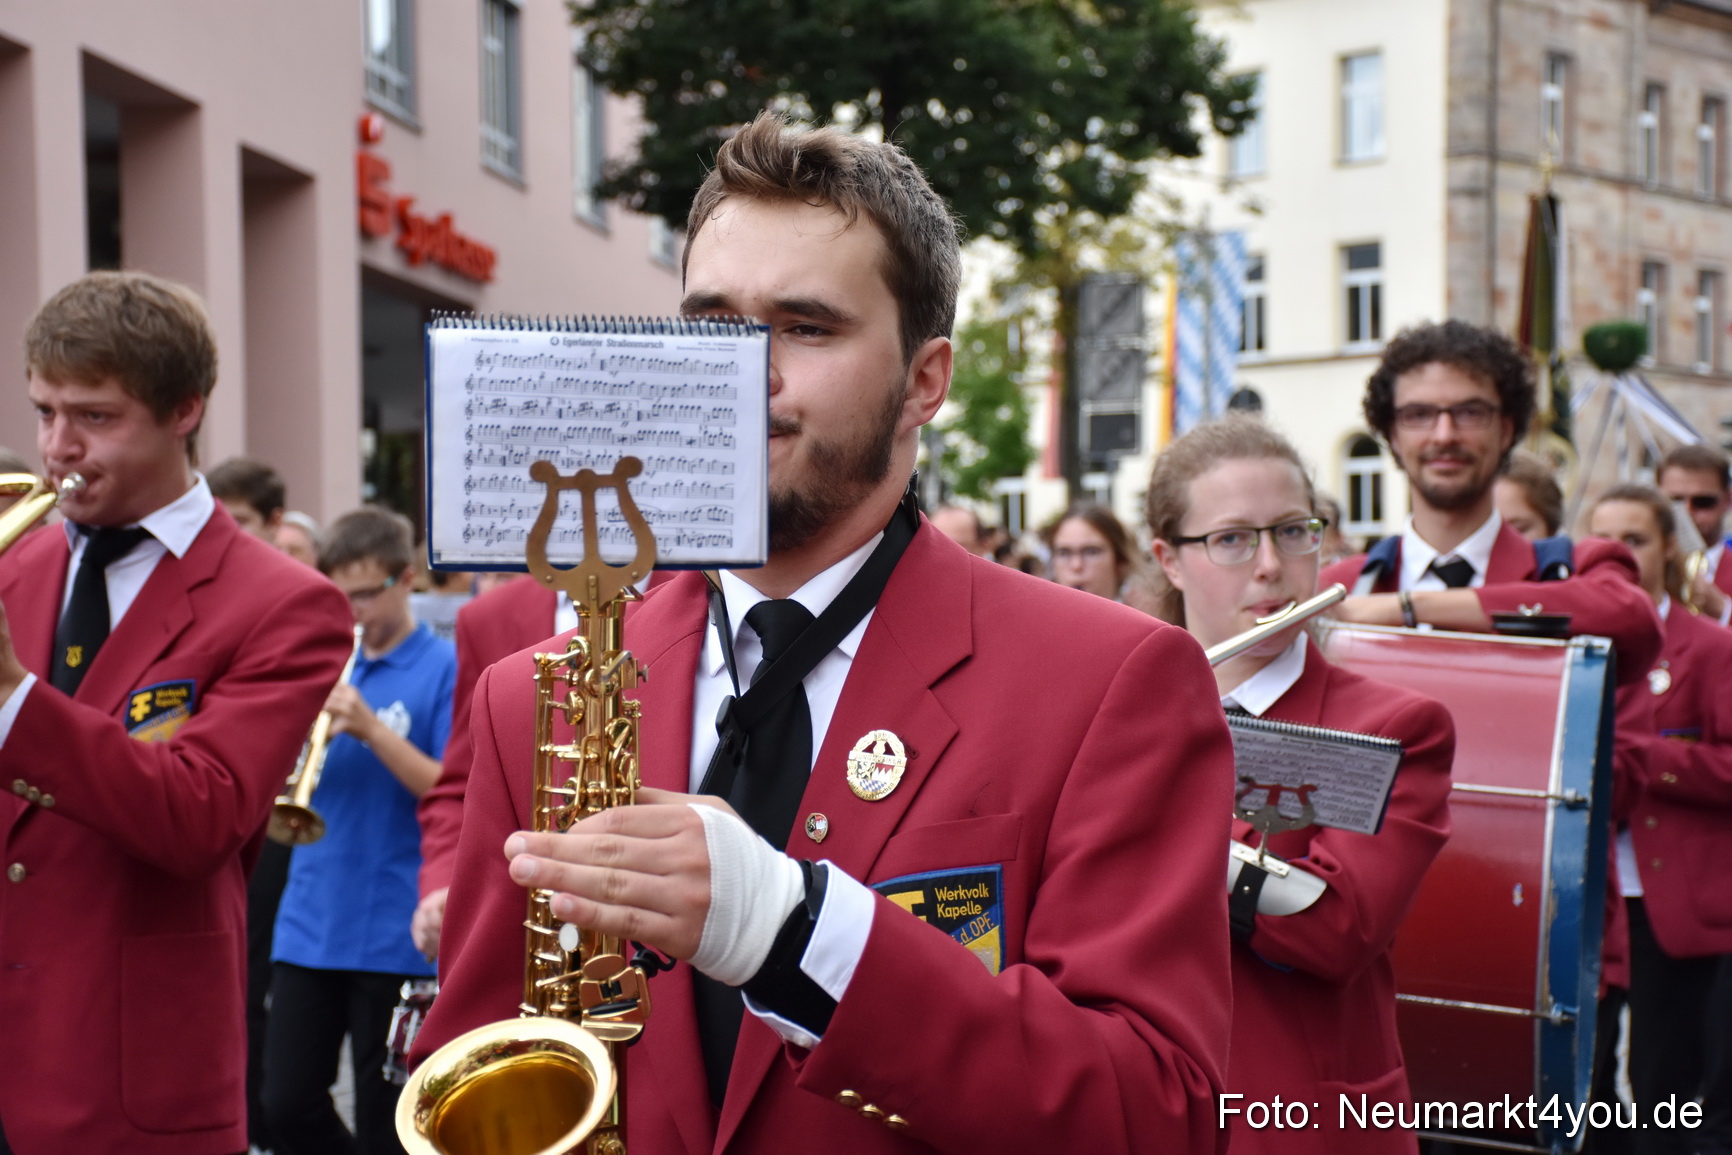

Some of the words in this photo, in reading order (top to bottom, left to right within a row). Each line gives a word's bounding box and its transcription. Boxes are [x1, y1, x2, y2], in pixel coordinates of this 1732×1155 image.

[606, 338, 664, 350] Straßenmarsch
[934, 883, 990, 902] Werkvolk
[936, 901, 983, 920] Kapelle
